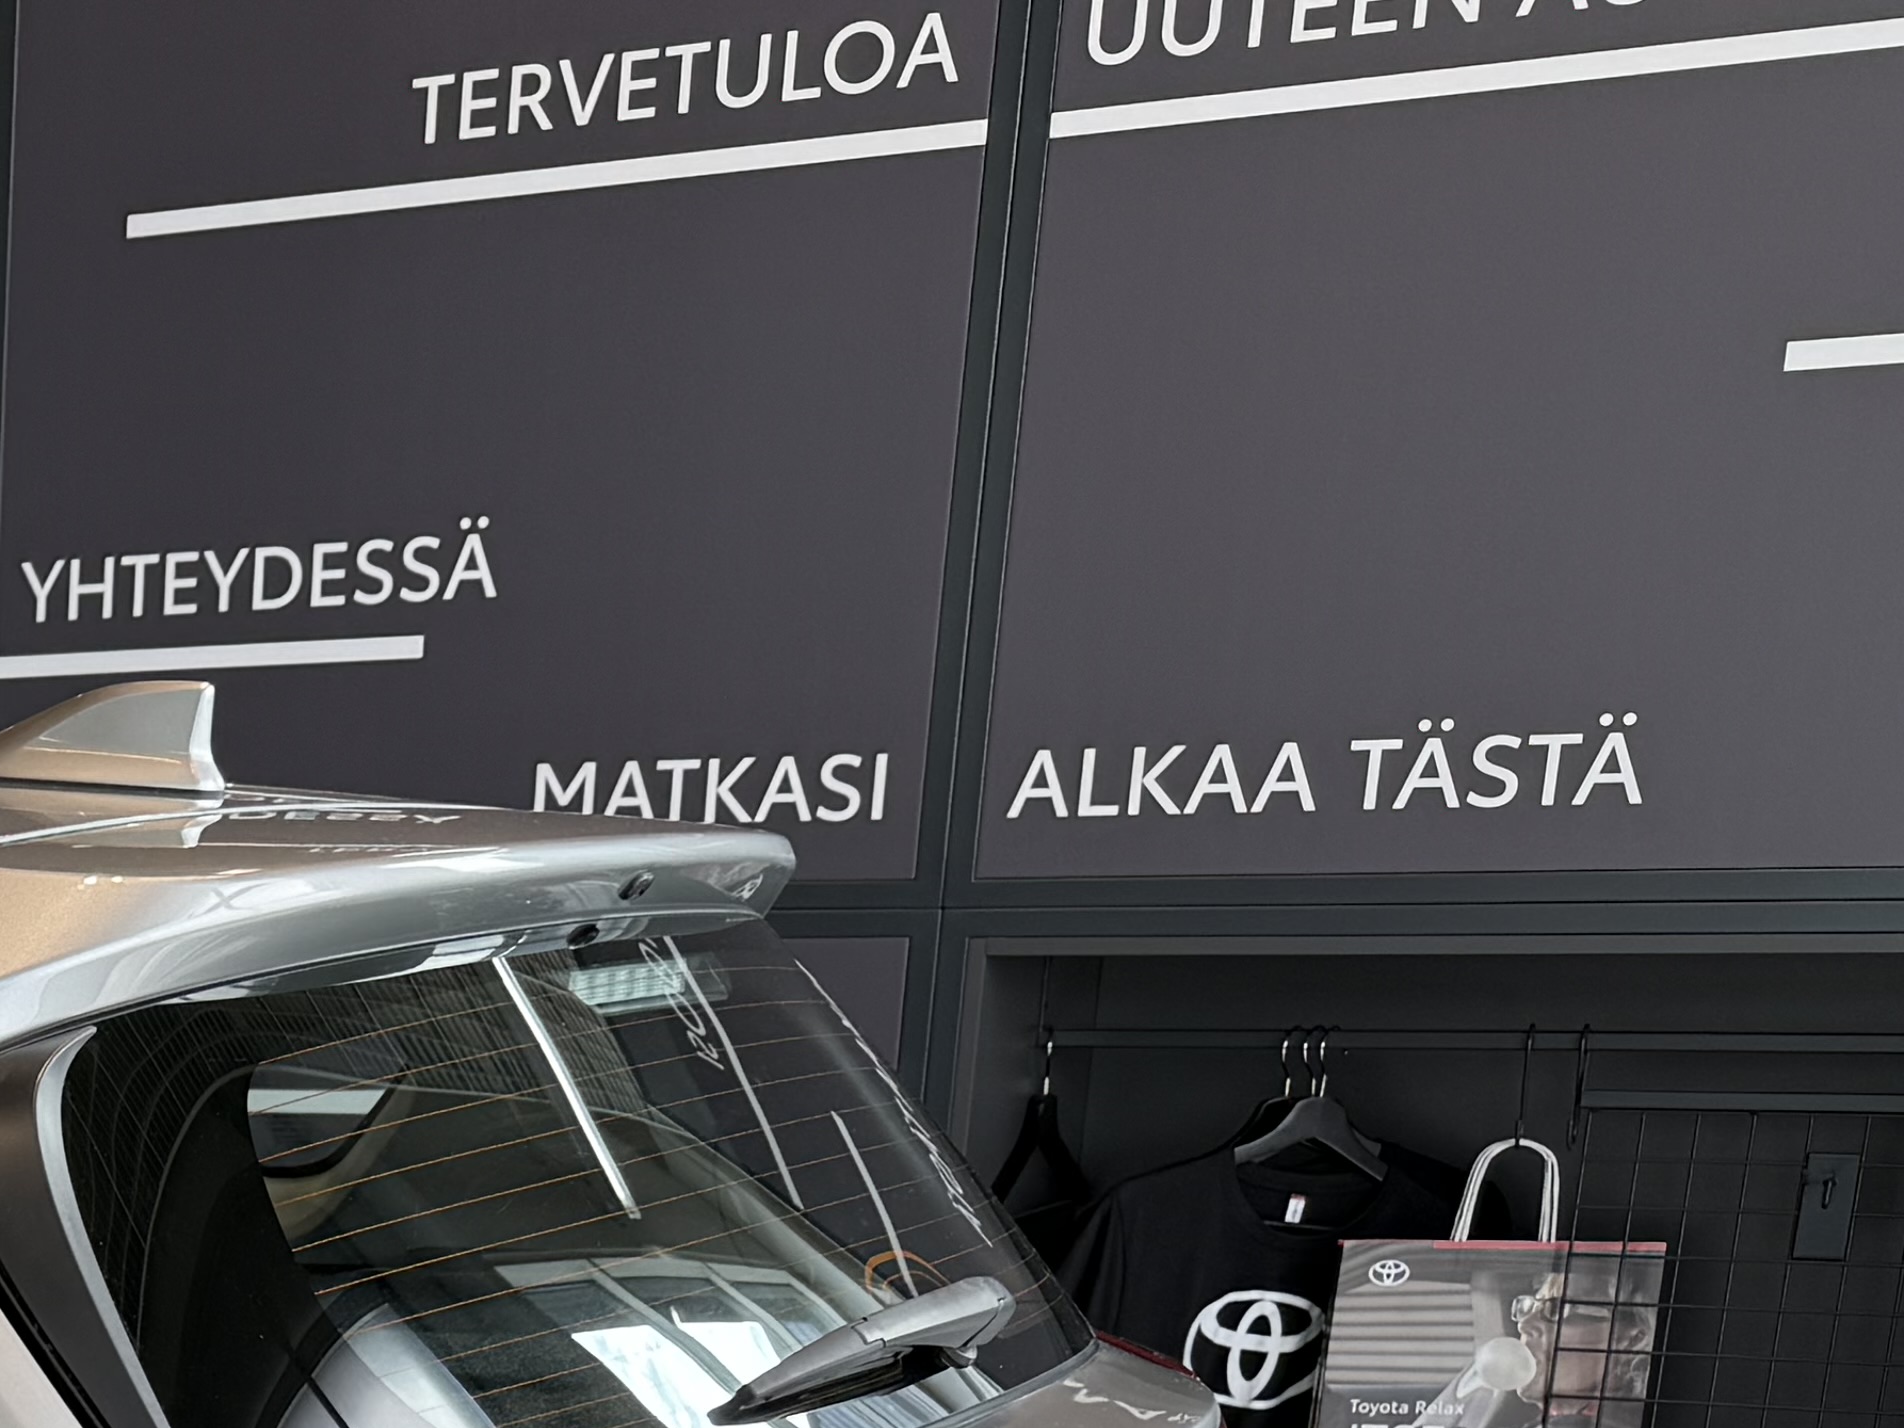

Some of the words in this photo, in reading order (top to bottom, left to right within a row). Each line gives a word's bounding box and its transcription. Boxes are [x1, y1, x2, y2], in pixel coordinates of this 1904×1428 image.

[412, 13, 958, 144] TERVETULOA
[22, 516, 497, 622] YHTEYDESSÄ
[530, 753, 888, 824] MATKASI
[1007, 742, 1316, 819] ALKAA
[1351, 712, 1643, 811] TÄSTÄ
[1350, 1399, 1409, 1416] Toyota
[1415, 1400, 1465, 1415] Relax
